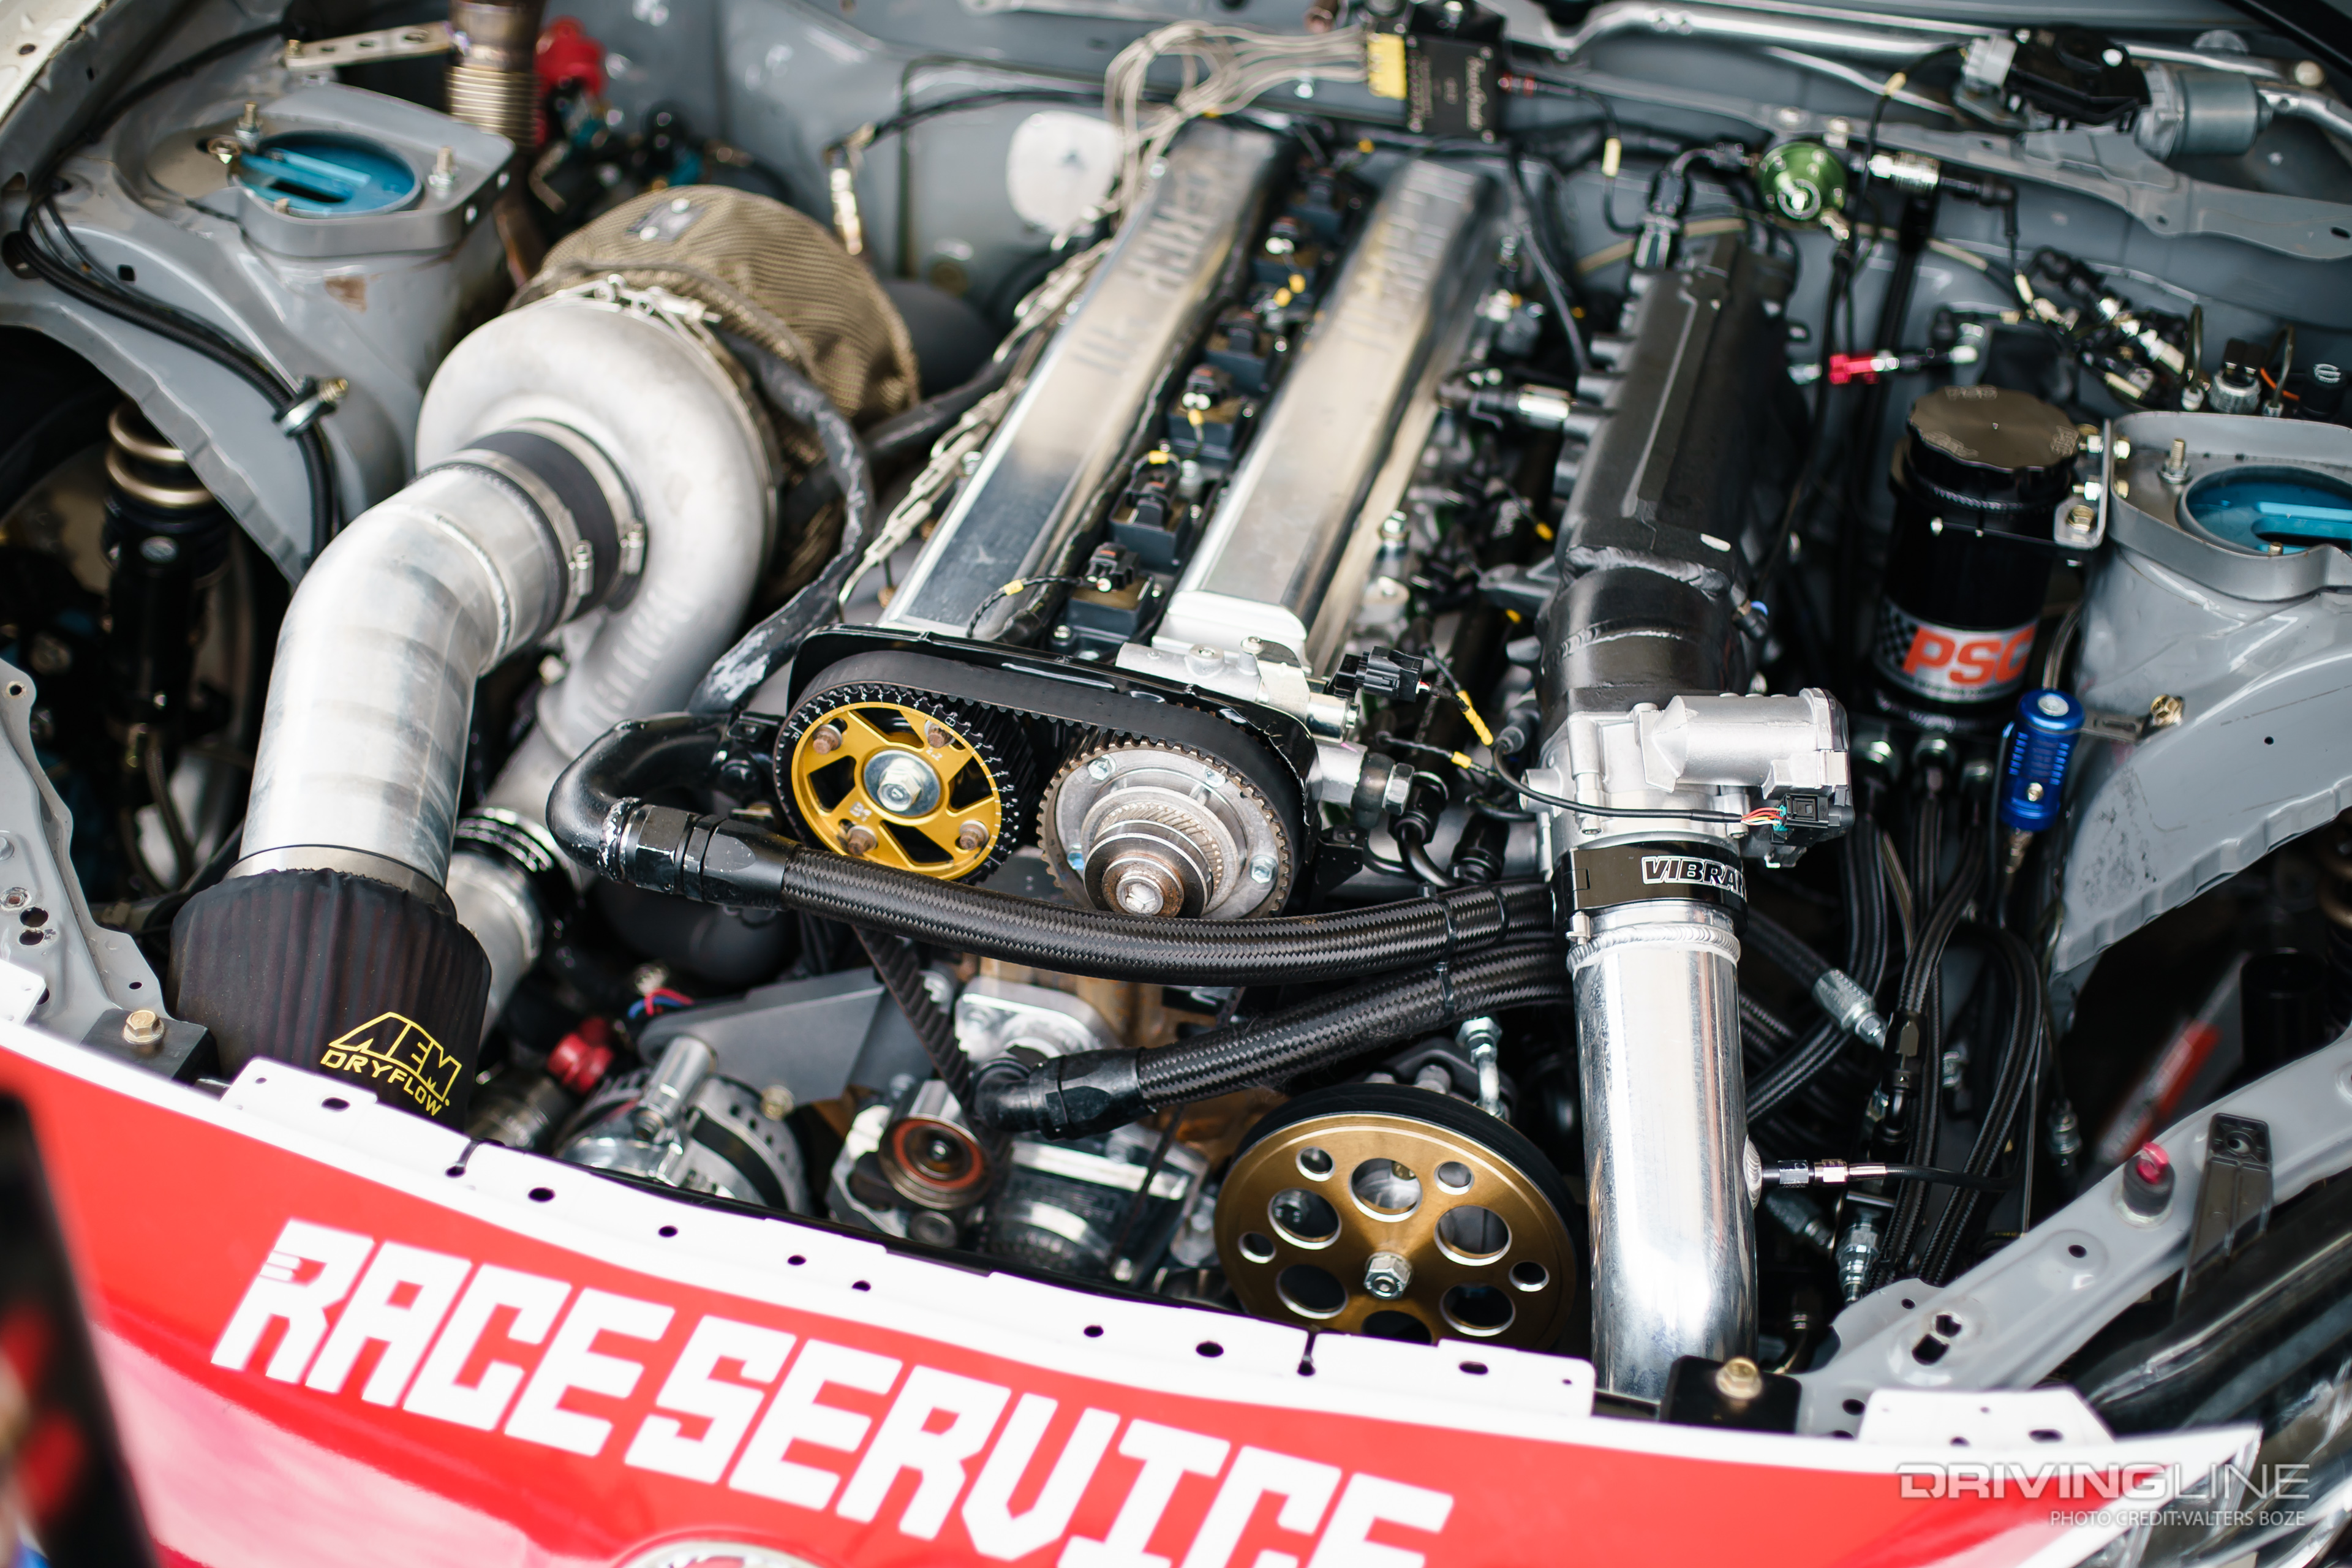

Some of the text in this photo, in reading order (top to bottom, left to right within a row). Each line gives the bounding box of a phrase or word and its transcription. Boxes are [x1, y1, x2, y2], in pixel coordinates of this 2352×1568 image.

[1902, 624, 2035, 685] PSC
[320, 1049, 442, 1117] DRYFLOW
[328, 1011, 462, 1102] AEM
[210, 1218, 676, 1458] RACE
